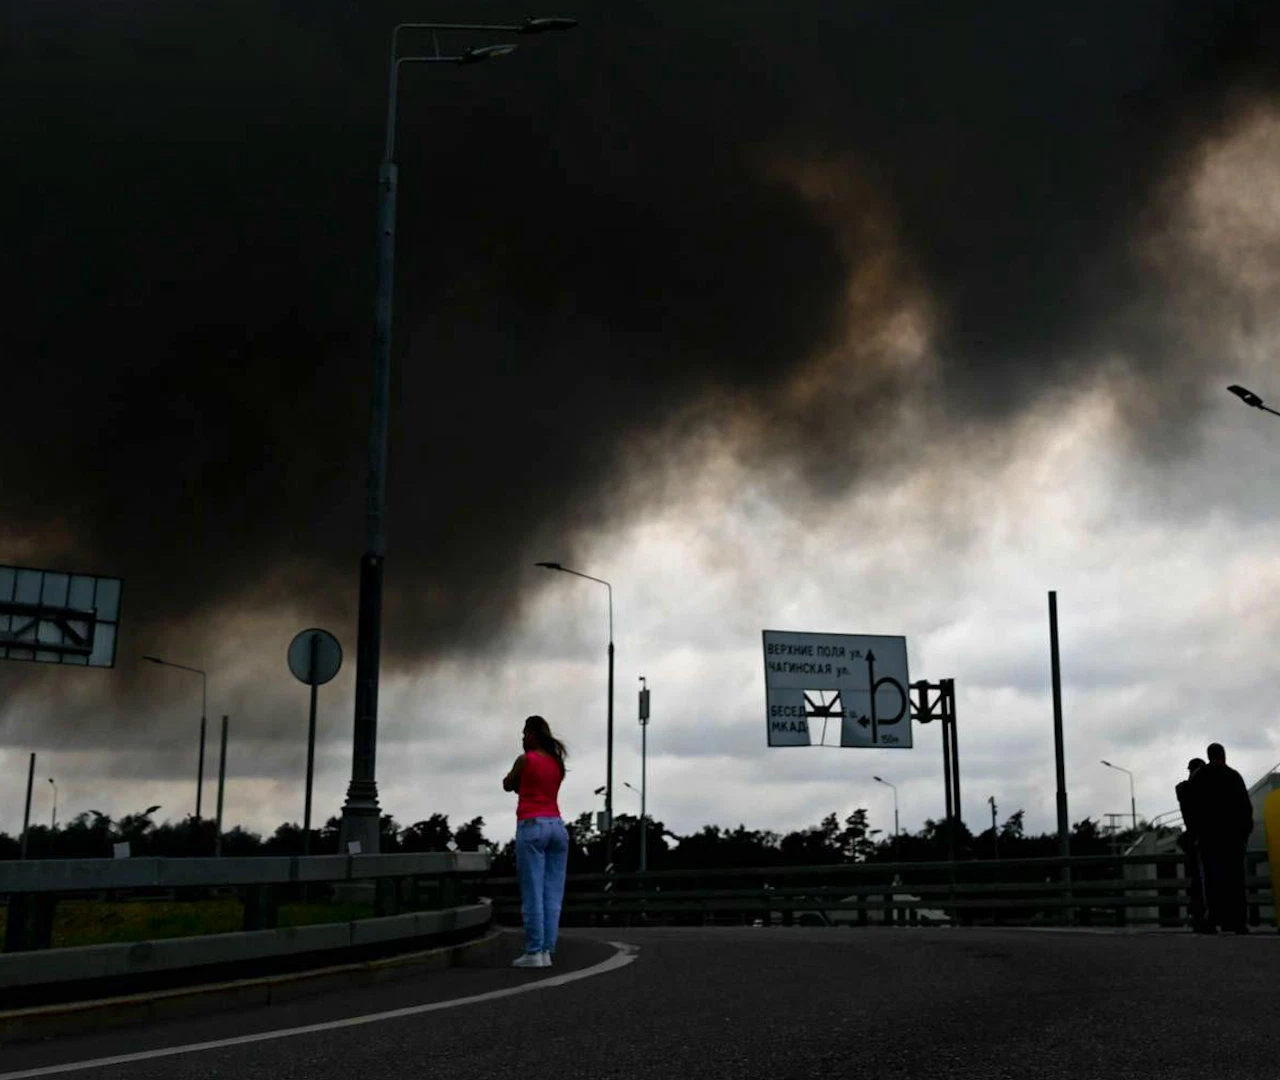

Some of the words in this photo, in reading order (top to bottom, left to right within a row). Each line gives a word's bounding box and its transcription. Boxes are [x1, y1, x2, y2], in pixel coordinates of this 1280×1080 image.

[767, 643, 813, 656] ВЕРХНИЕ
[816, 645, 845, 658] ПОЛЯ
[768, 662, 832, 675] ЧАГИНСКАЯ
